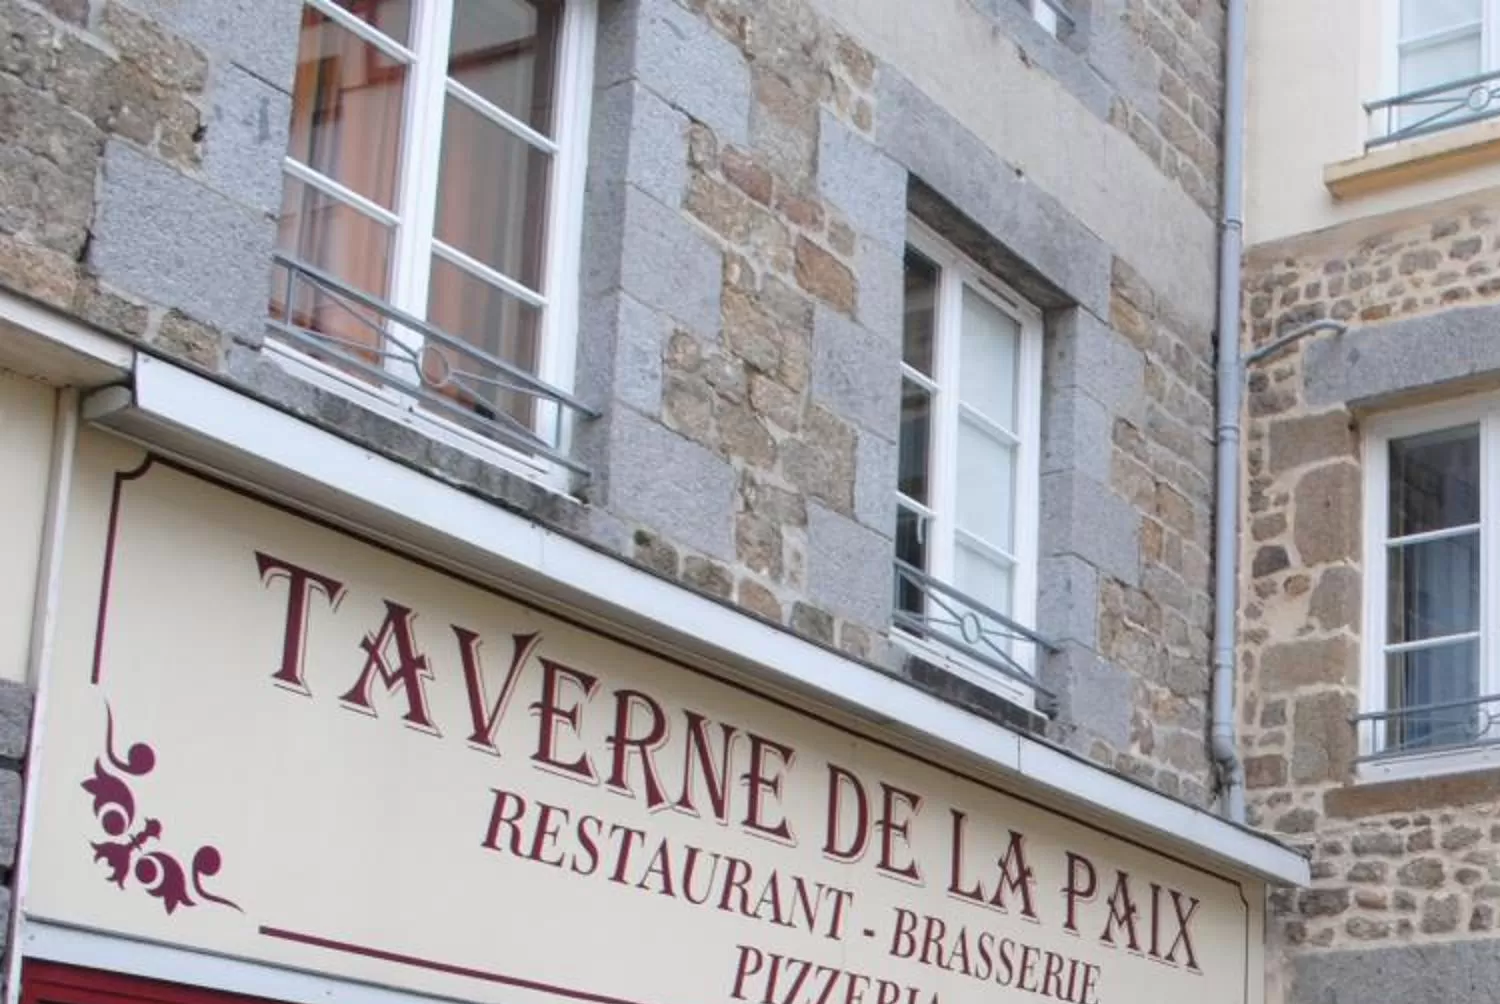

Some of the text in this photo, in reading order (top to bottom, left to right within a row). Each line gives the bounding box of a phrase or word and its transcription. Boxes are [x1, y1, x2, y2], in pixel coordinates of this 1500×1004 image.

[255, 550, 1204, 977] TAVERNE DE LA PAIX
[481, 788, 854, 941] RESTAURANT
